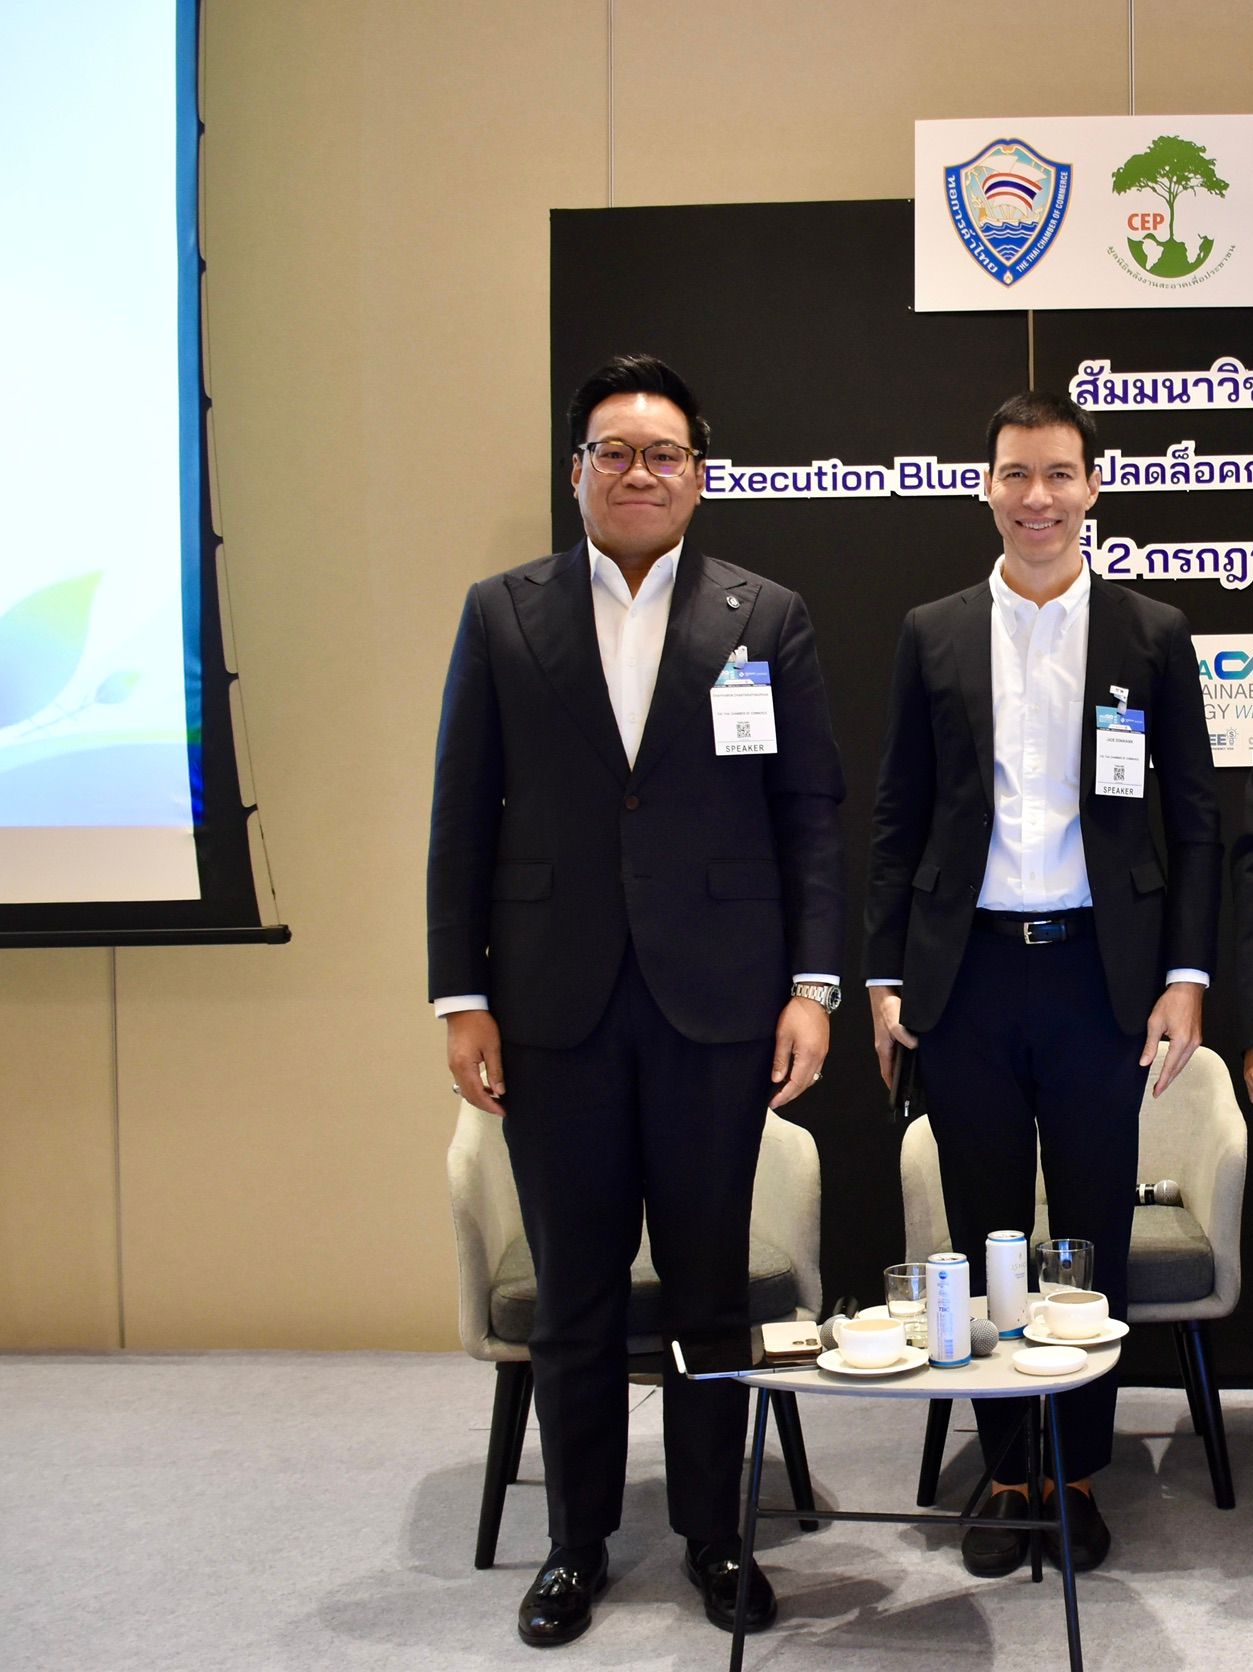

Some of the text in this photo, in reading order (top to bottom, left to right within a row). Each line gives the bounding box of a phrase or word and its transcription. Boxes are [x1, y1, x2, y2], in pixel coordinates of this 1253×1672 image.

[947, 175, 998, 273] หอการค้าไทย
[1015, 171, 1069, 273] THE THAI CHAMBER OF COMMERCE
[1127, 213, 1165, 231] CEP
[706, 463, 886, 493] Execution
[900, 462, 986, 496] Blue
[1107, 543, 1131, 574] 2
[726, 744, 765, 753] SPEAKER
[1103, 786, 1134, 796] SPEAKER
